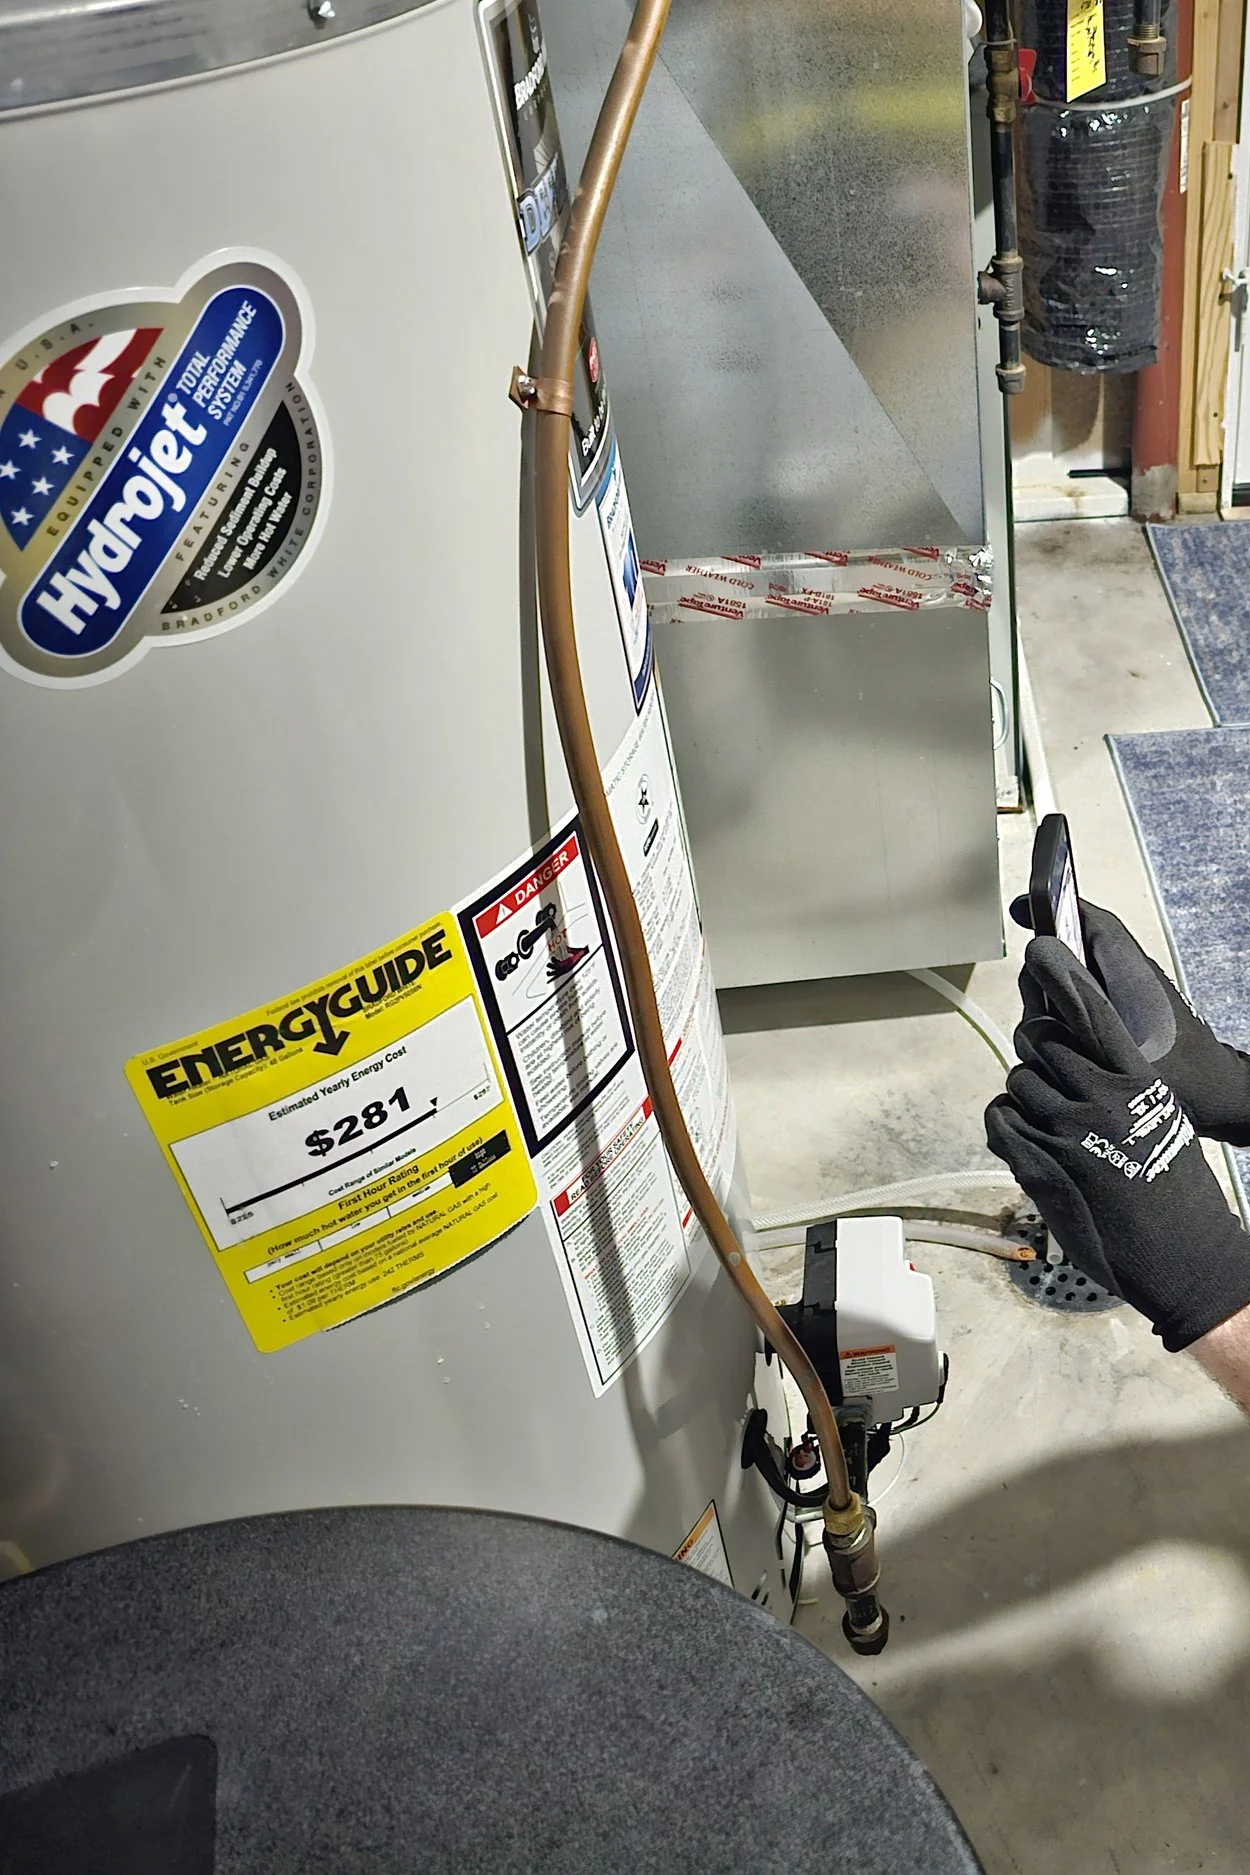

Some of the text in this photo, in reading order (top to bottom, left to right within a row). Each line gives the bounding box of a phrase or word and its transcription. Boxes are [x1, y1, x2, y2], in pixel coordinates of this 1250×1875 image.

[176, 351, 210, 394] TOTAL
[193, 300, 257, 408] PERFORMANCE
[208, 360, 247, 420] SYSTEM
[47, 357, 166, 536] EQUIPPED WITH
[36, 399, 208, 636] Hydrojet
[162, 381, 318, 631] BRADFORD WHITE CORPORATION
[175, 442, 250, 562] FEATURING
[193, 447, 278, 581] Reduced Sediment Buildup
[216, 467, 287, 578] Lower Operating Costs
[243, 491, 293, 571] More Hot Water
[685, 564, 726, 582] WEATHER
[728, 576, 753, 589] COLD
[866, 556, 905, 573] WEATHER
[907, 568, 931, 580] COLD
[717, 596, 746, 608] 1581A
[514, 850, 571, 905] DANGER
[547, 928, 569, 953] HOT
[146, 929, 453, 1099] ENERGYGUIDE
[268, 1044, 407, 1122] Estimated Yearly Energy Cost
[304, 1087, 411, 1157] $281
[266, 1237, 293, 1255] (How
[292, 1226, 321, 1243] much
[320, 1217, 337, 1232] hot
[337, 1205, 362, 1224] water
[363, 1197, 382, 1212] you
[381, 1188, 397, 1203] get
[396, 1184, 405, 1193] in
[406, 1175, 420, 1188] the
[420, 1165, 438, 1180] first
[437, 1152, 457, 1169] hour
[456, 1146, 466, 1157] of
[465, 1135, 483, 1152] use)
[337, 1163, 419, 1210] First Hour Rating
